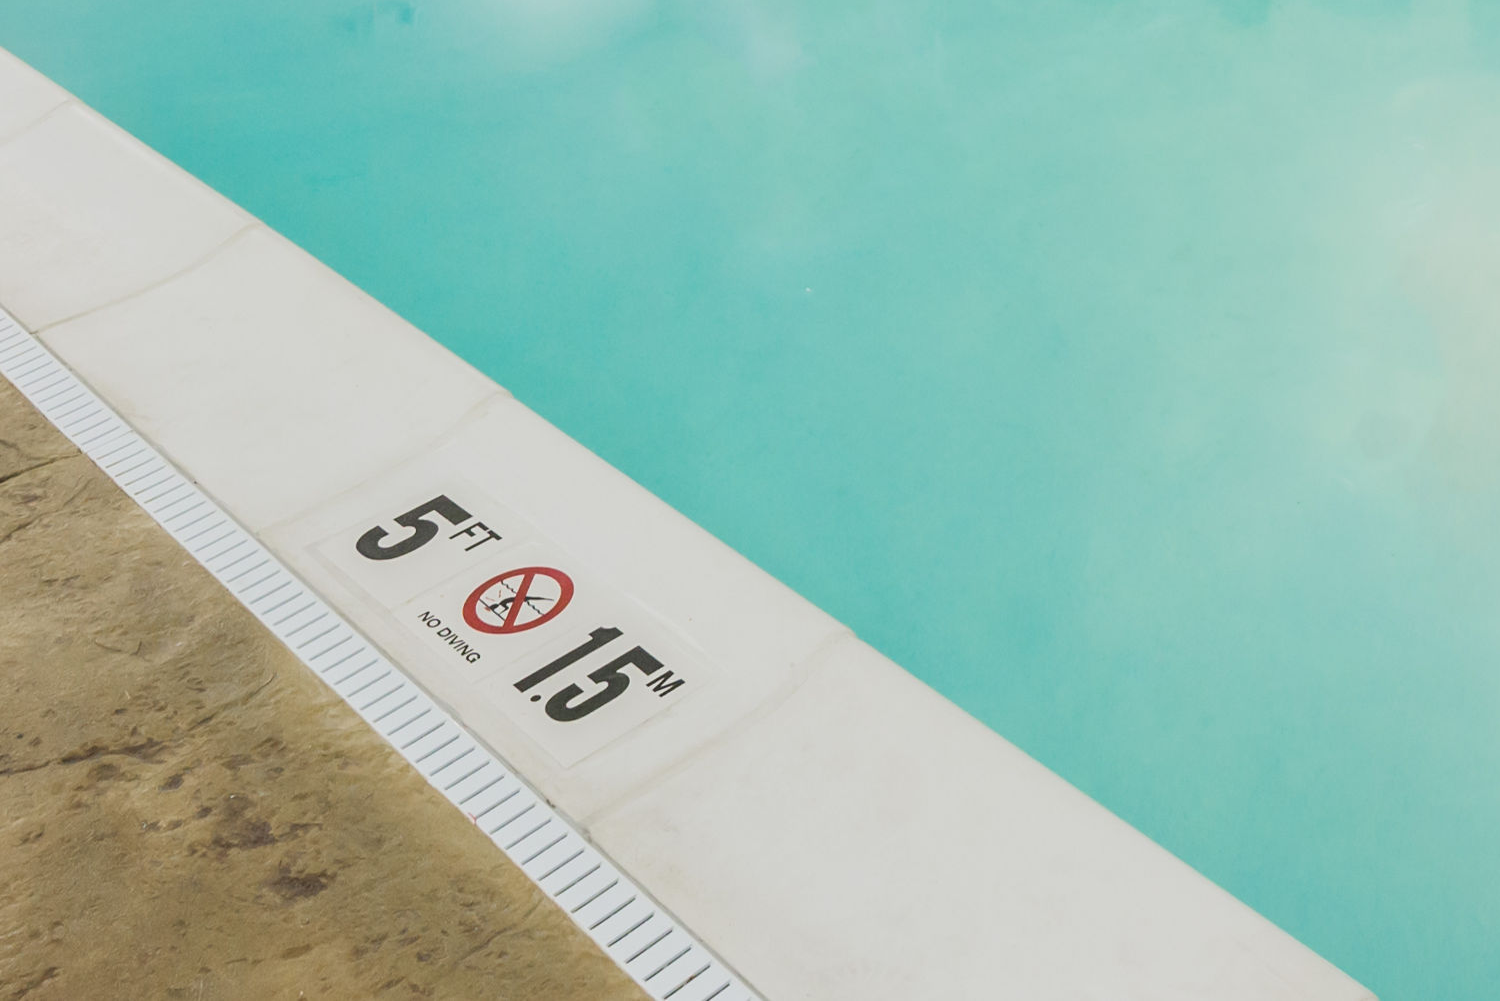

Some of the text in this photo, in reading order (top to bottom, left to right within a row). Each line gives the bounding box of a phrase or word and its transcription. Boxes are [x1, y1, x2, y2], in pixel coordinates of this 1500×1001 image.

[355, 494, 503, 561] 5 FT
[417, 610, 481, 664] NO DIVING
[513, 626, 686, 722] 1.5 M
